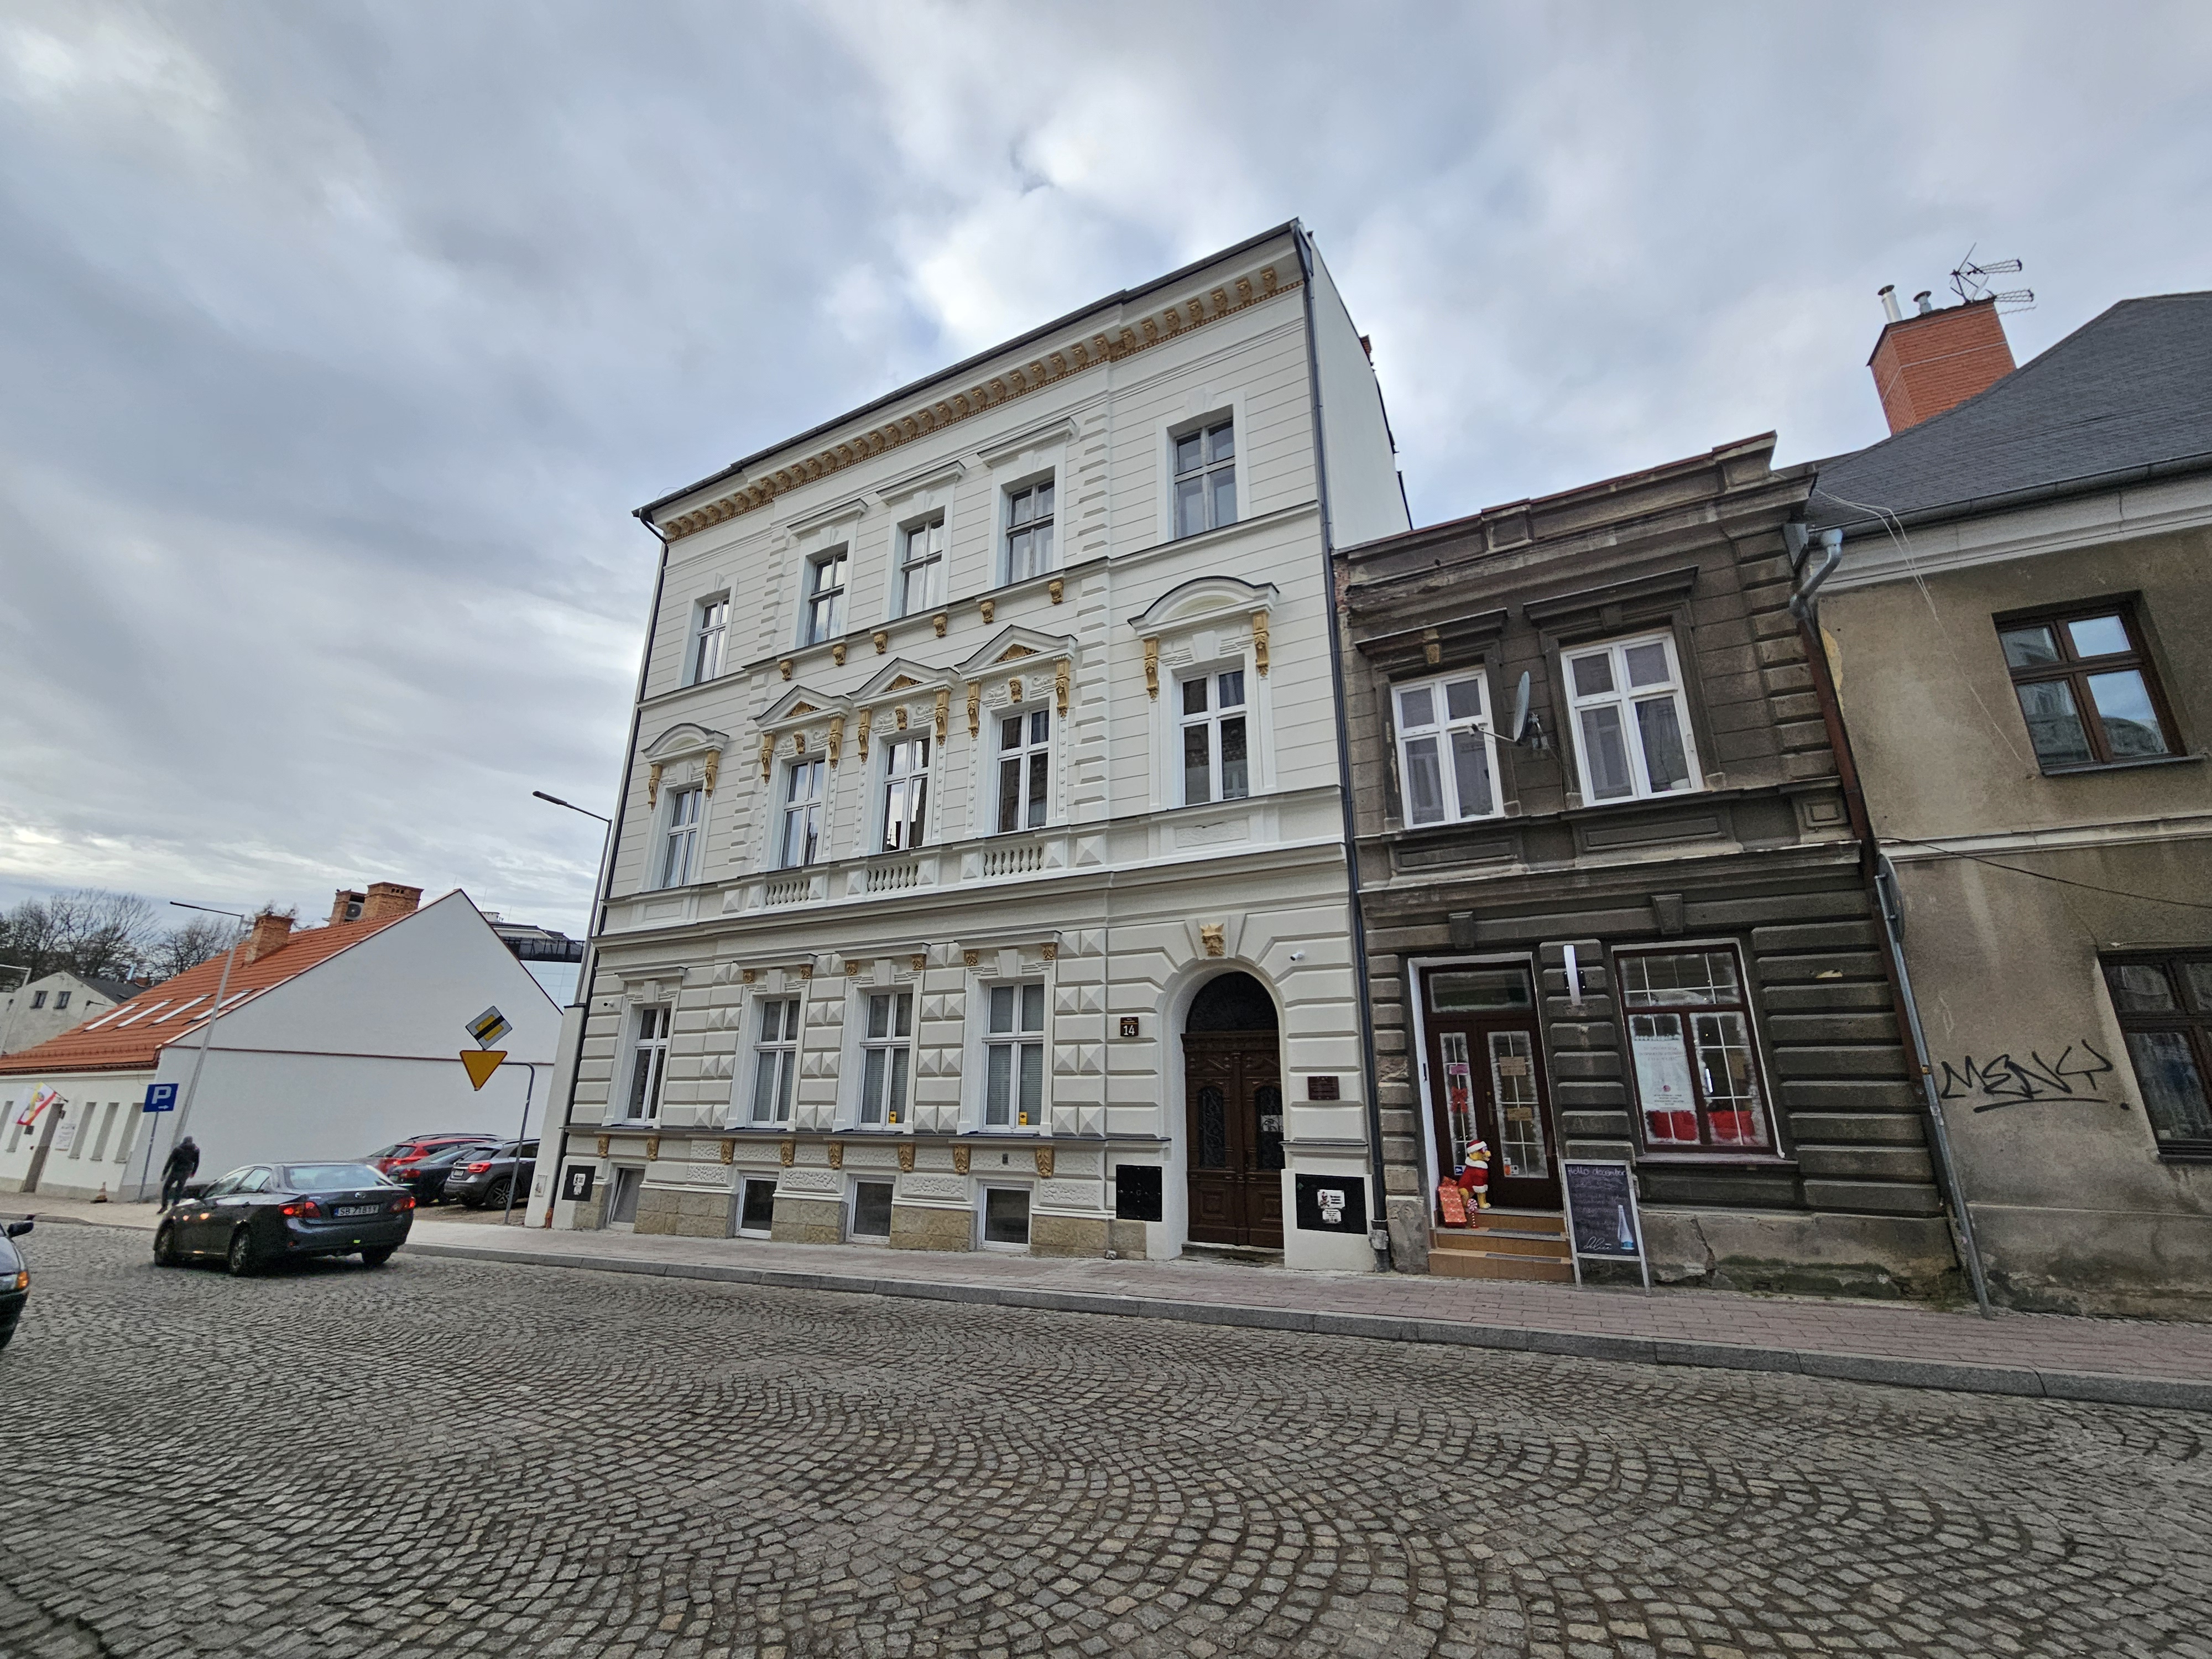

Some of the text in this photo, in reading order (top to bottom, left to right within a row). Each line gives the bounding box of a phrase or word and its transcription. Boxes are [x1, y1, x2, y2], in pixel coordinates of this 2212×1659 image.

[1123, 1025, 1135, 1036] 14
[151, 1086, 172, 1104] P
[1567, 1166, 1590, 1176] Hello
[340, 1207, 351, 1215] SB
